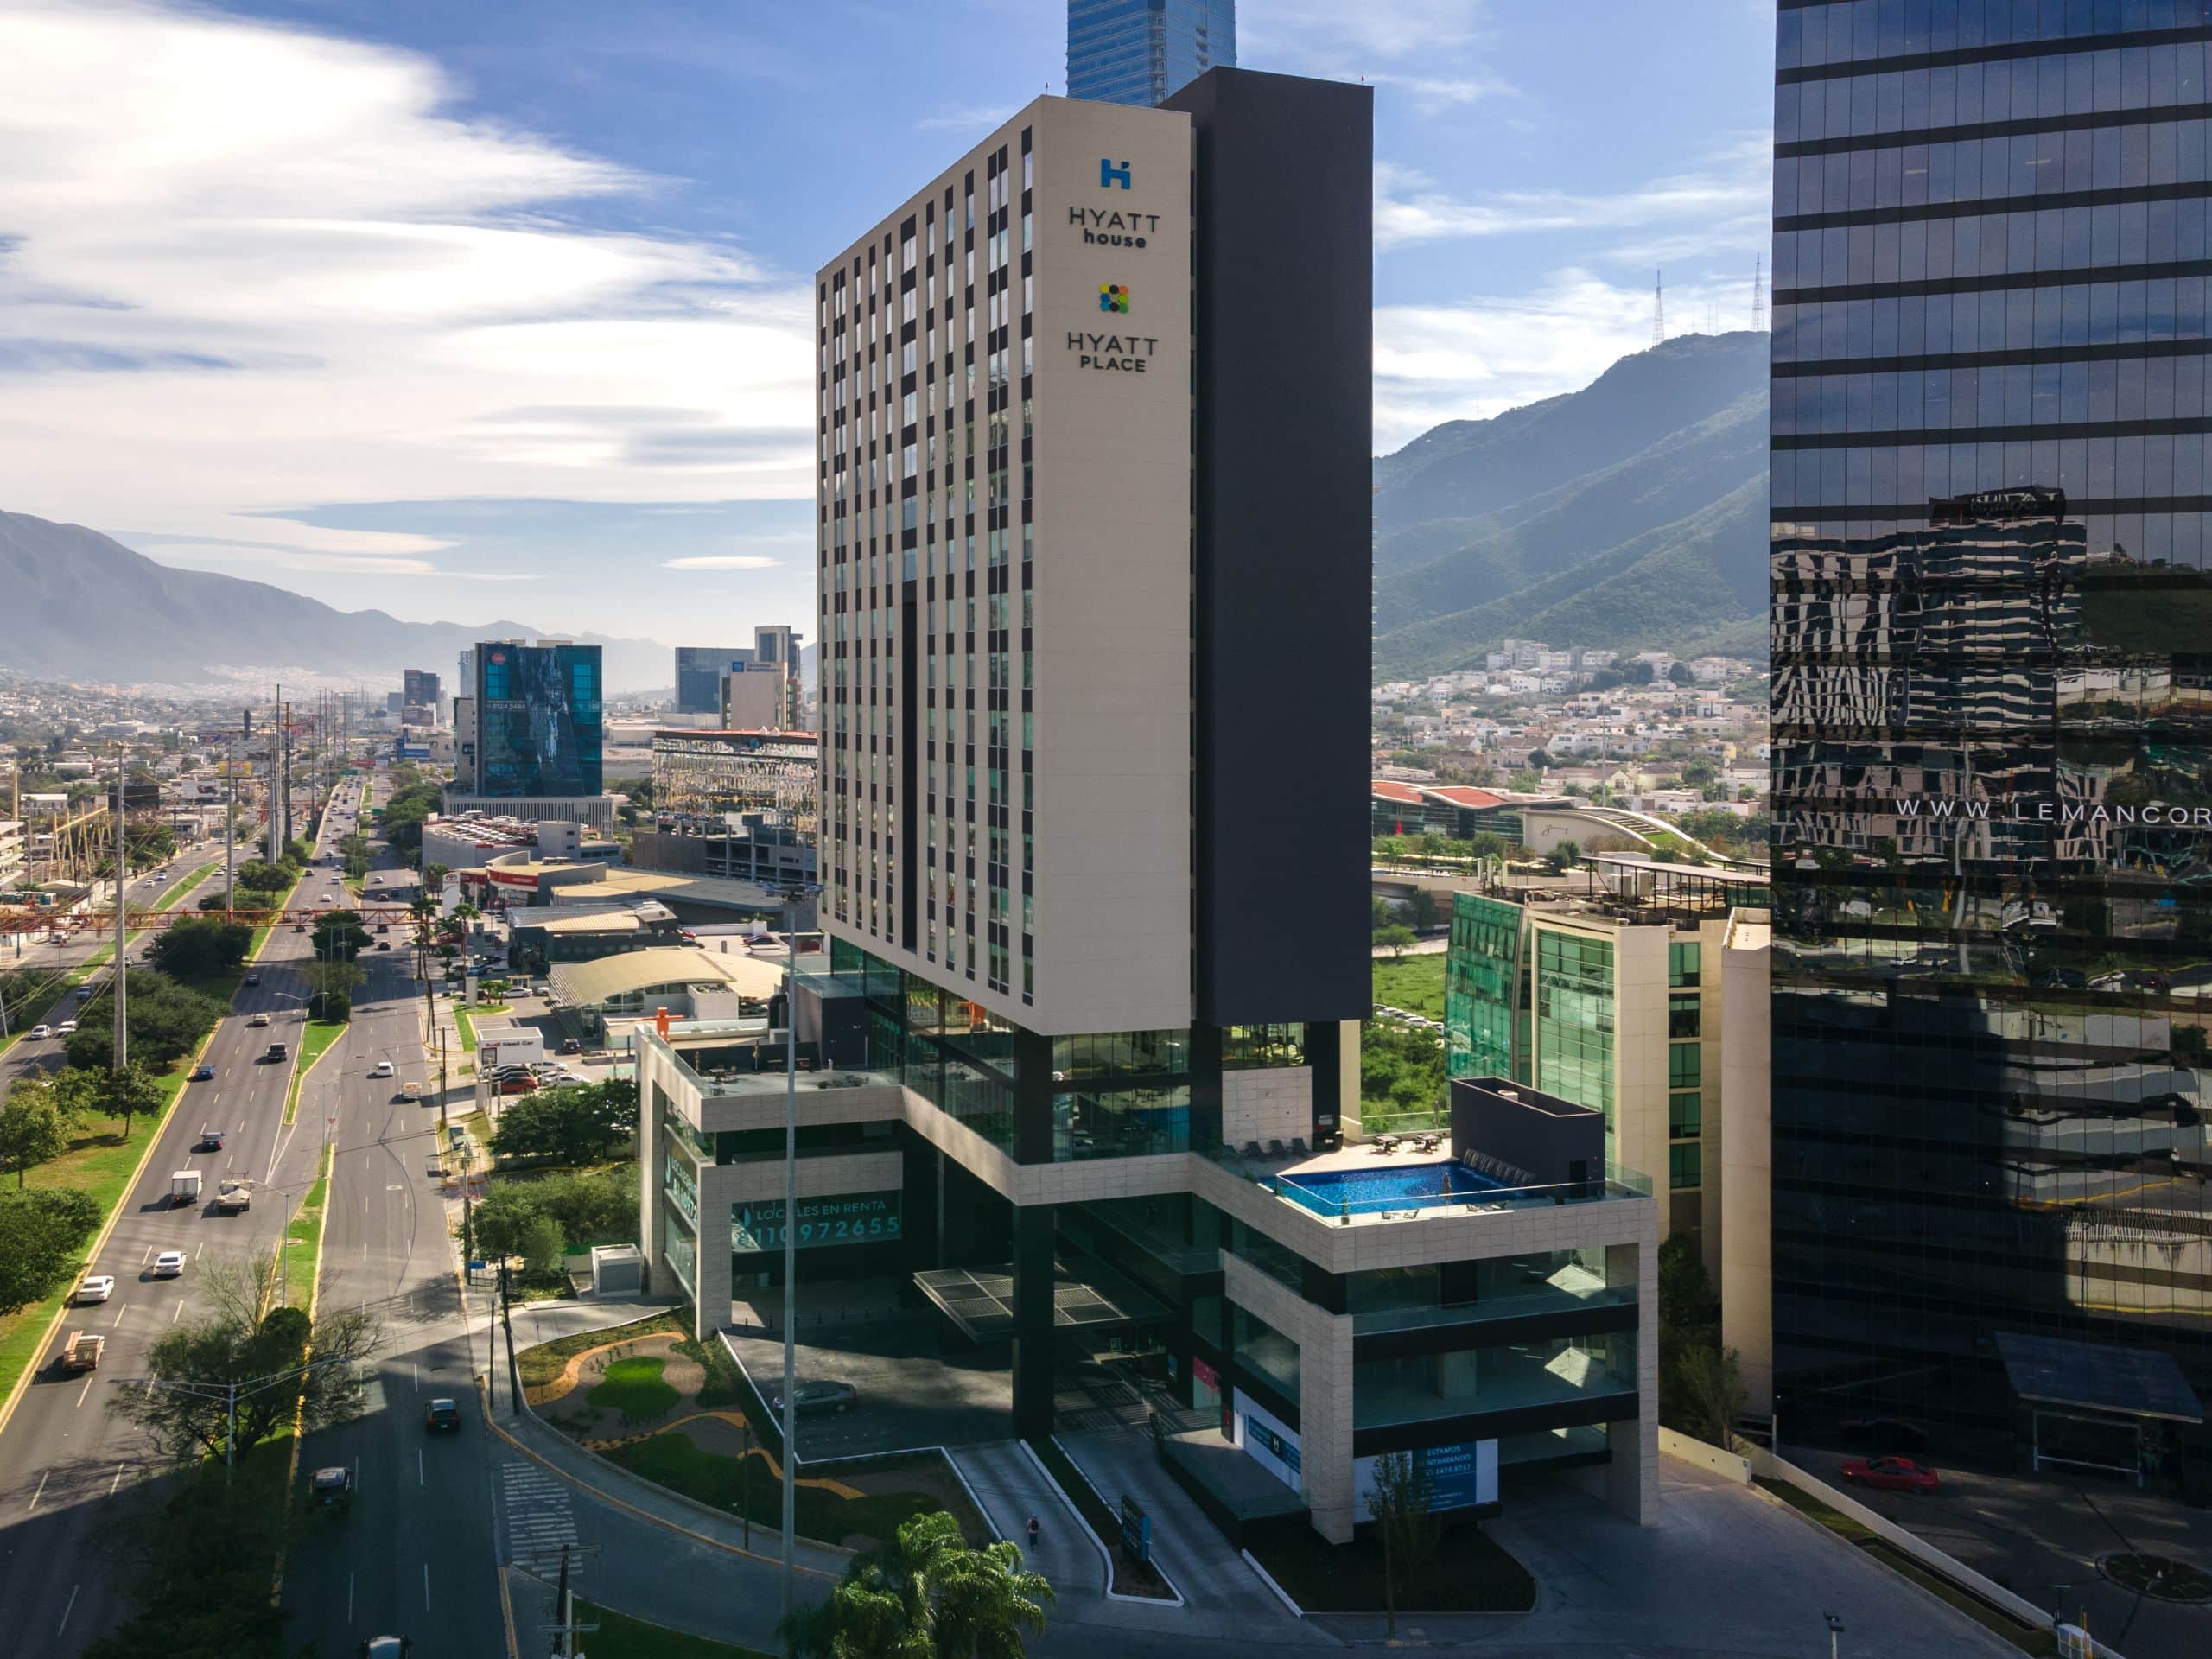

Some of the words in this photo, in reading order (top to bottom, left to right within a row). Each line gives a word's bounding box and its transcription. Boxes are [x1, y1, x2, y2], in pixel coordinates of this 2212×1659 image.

[1069, 207, 1160, 232] HYATT
[1084, 228, 1146, 248] house
[1068, 332, 1158, 356] HYATT
[1080, 355, 1146, 372] PLACE
[757, 1206, 819, 1220] LOCLES
[823, 1204, 840, 1216] EN
[844, 1201, 886, 1213] RENTA
[1427, 1446, 1462, 1457] ESTAMOS
